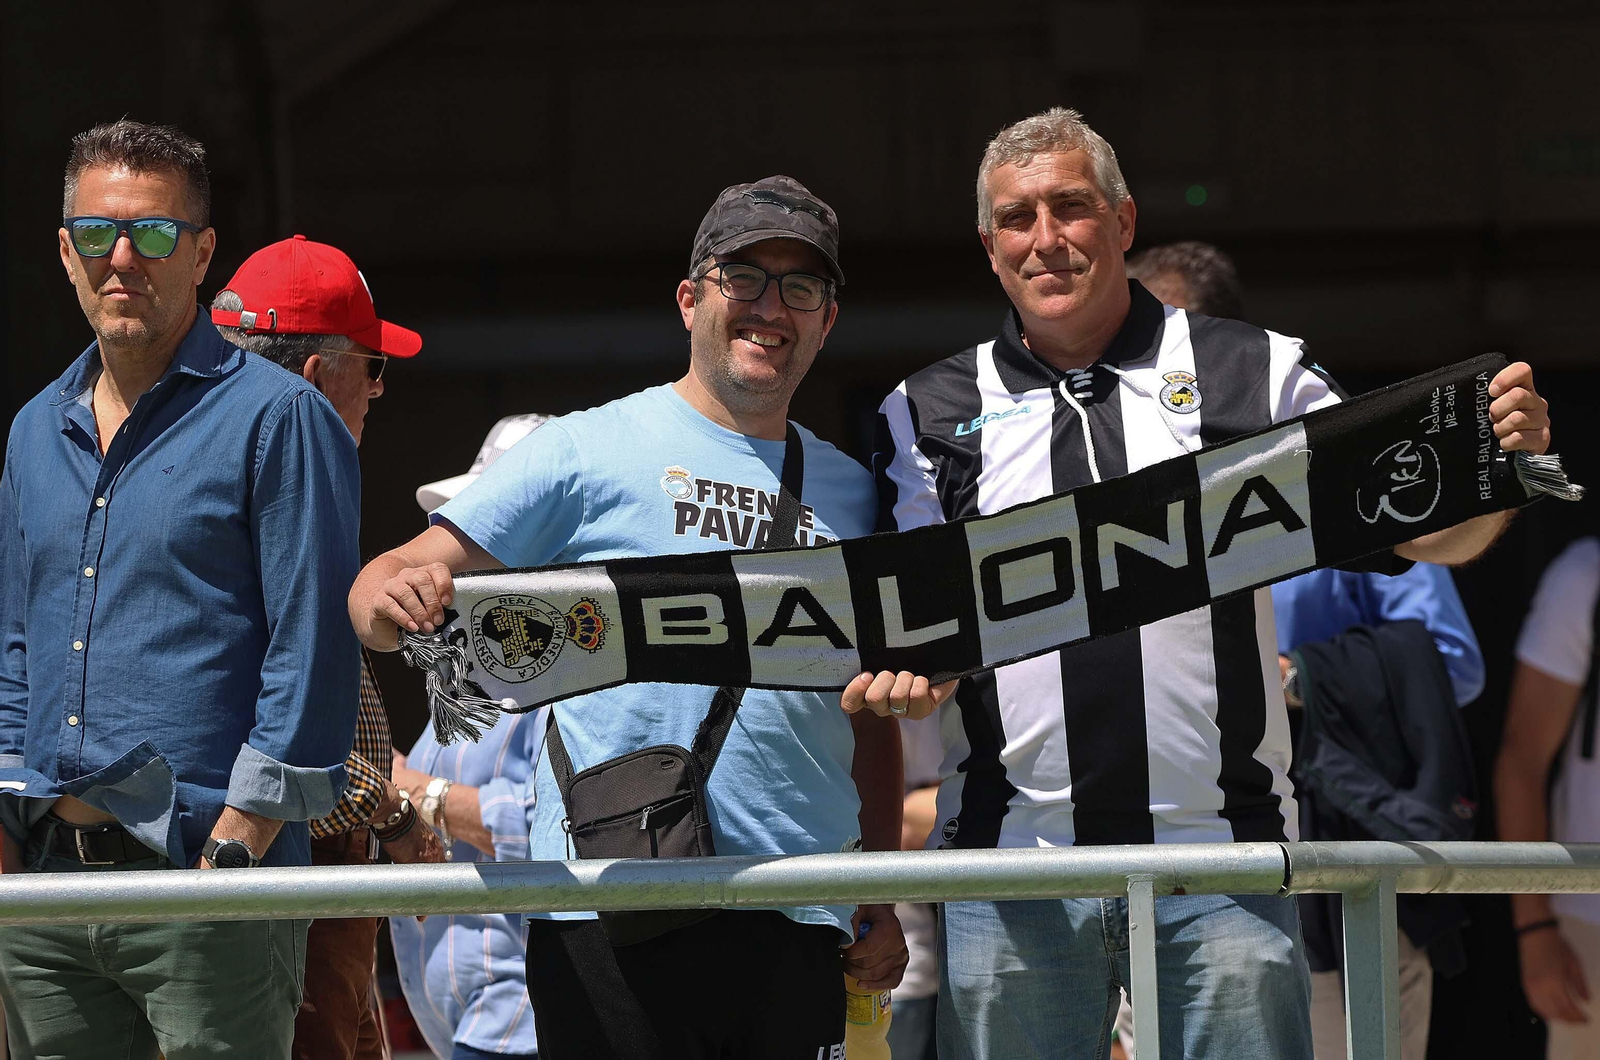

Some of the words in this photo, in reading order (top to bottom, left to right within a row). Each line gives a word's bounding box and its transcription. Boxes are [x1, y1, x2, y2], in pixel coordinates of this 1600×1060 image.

[1476, 371, 1491, 464] BALOMPEDICA
[695, 478, 814, 530] FRENE
[1478, 465, 1492, 500] REAL
[641, 474, 1308, 650] BALONA
[498, 597, 536, 606] REAL
[472, 614, 498, 671] LINENSE
